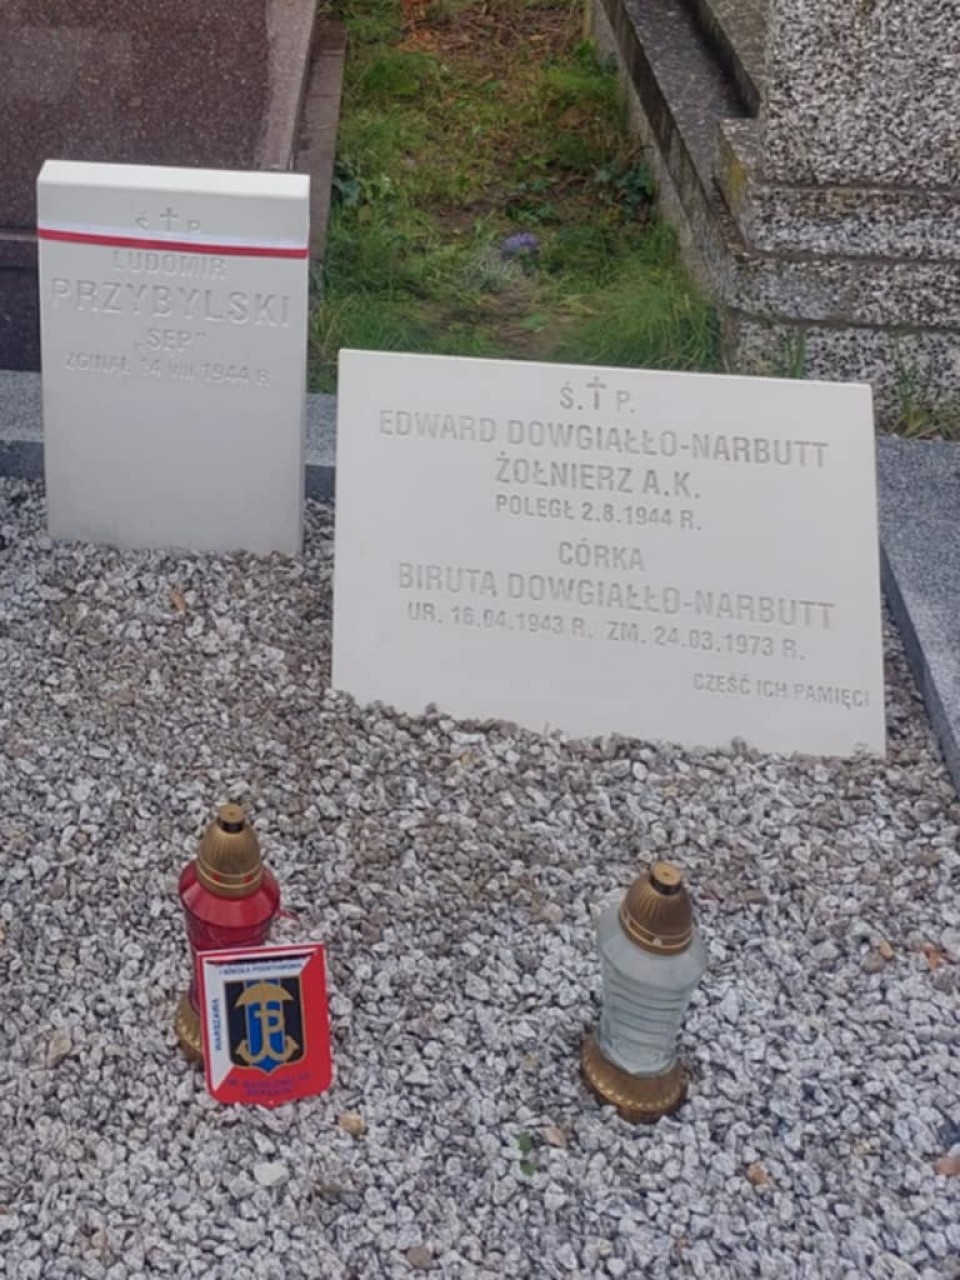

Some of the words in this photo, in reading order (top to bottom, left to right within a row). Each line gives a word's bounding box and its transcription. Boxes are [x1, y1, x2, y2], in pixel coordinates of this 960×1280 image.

[111, 250, 229, 279] LUDOMIR
[50, 277, 290, 329] PRZYBYLSKI
[379, 410, 497, 444] EDWARD
[507, 419, 829, 469] DOWGIAŁŁO-NARBUTT
[495, 451, 634, 494] ŻOŁNIERZ
[641, 470, 702, 499] A.K.
[496, 495, 576, 521] POLEGŁ
[581, 502, 672, 528] 2.8.1944
[680, 509, 703, 531] R.
[557, 537, 646, 573] CÓRKA
[398, 563, 498, 598] BIRUTA
[506, 571, 835, 630] DOWGIAŁŁO-NARBUTT
[407, 601, 444, 625] UR.
[450, 605, 565, 636] 16.04.1943
[571, 617, 593, 640] R.
[606, 619, 648, 645] ZM.
[654, 625, 776, 659] 24.03.1973
[782, 638, 806, 661] R.
[693, 672, 752, 697] CZEŚĆ
[756, 678, 788, 700] ICH
[793, 682, 871, 710] PAMIĘCI
